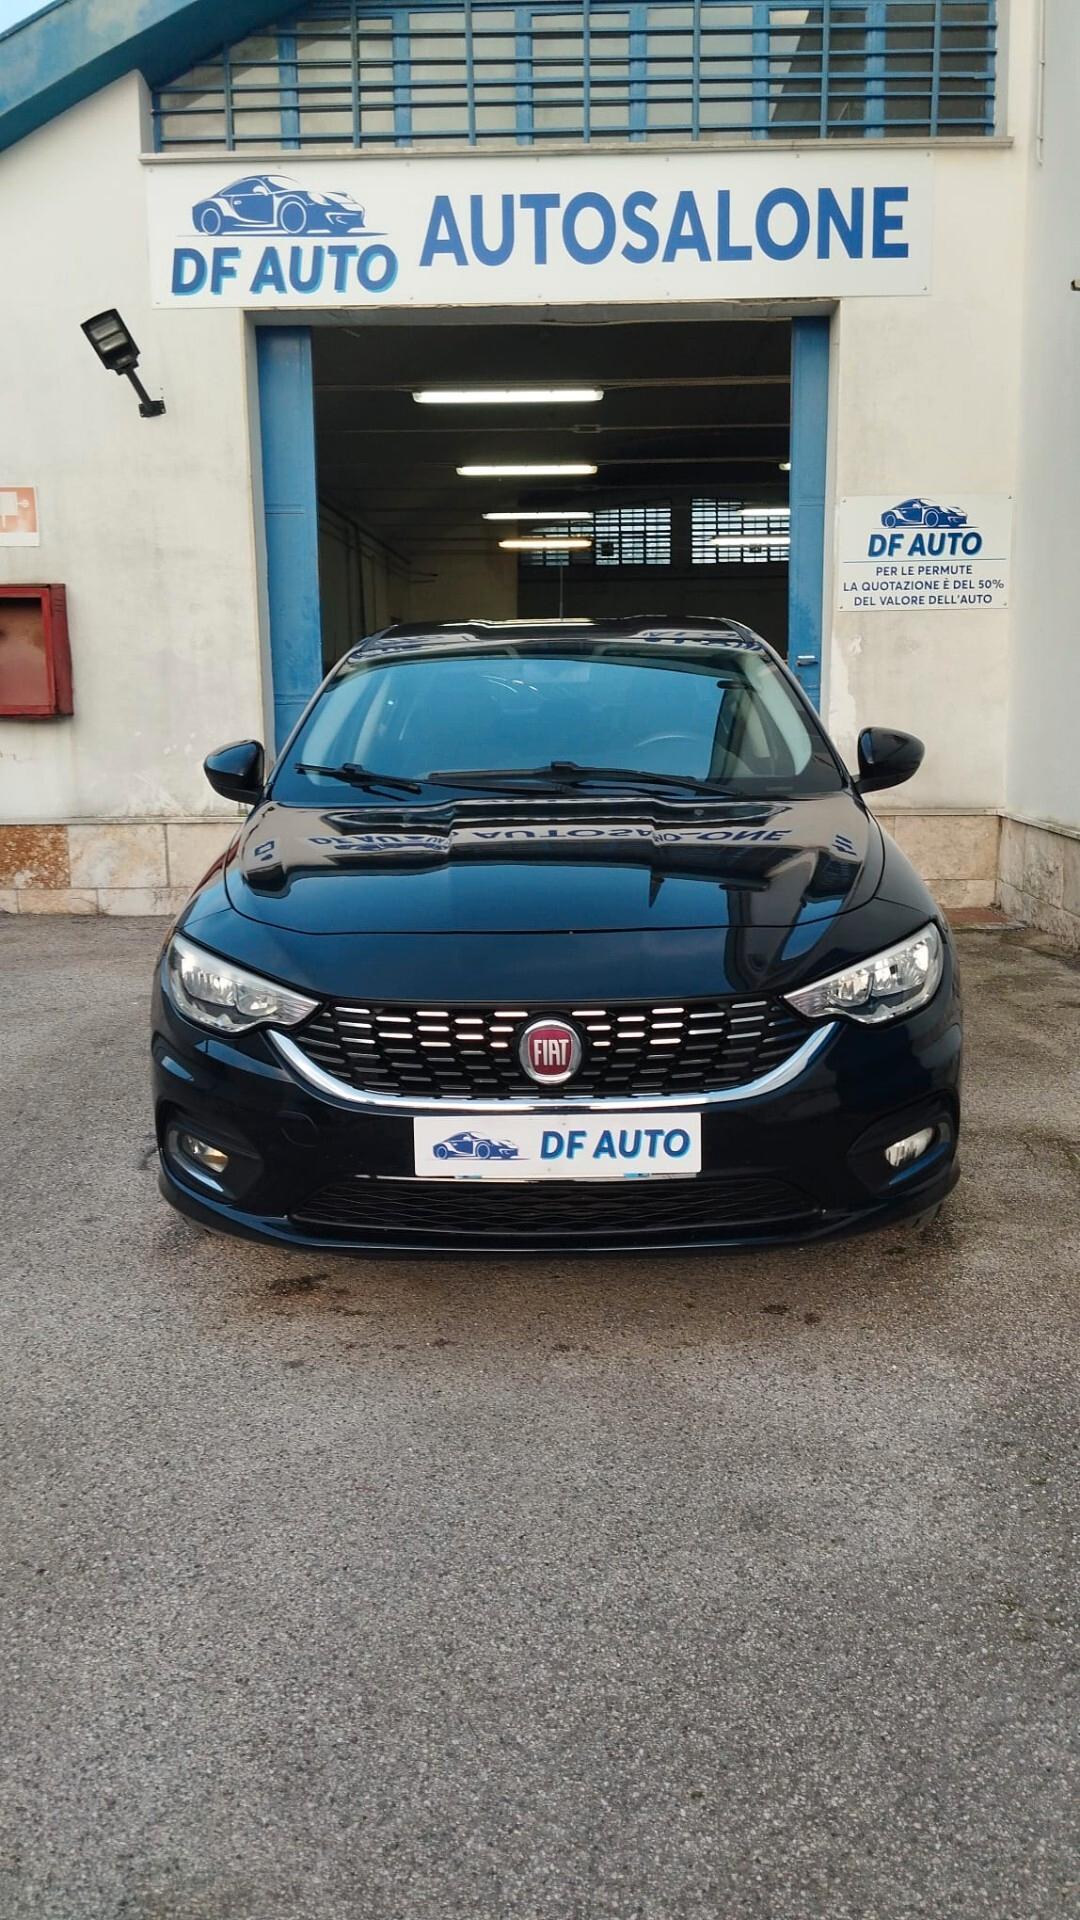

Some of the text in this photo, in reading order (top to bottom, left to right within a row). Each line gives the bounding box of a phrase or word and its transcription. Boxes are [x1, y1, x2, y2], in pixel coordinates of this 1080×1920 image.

[418, 186, 910, 267] AUTOSALONE
[171, 243, 399, 296] DF AUTO
[867, 531, 983, 558] DF AUTO
[876, 564, 973, 577] PER LE PERMUTE
[843, 581, 858, 592] LA
[861, 580, 940, 592] QUOTAZIONE
[953, 579, 975, 590] DEL
[978, 579, 1005, 590] 50%
[854, 594, 993, 607] DEL VALORE DELL'AUTO
[533, 1038, 570, 1067] FIAT
[539, 1128, 692, 1160] DF AUTO
